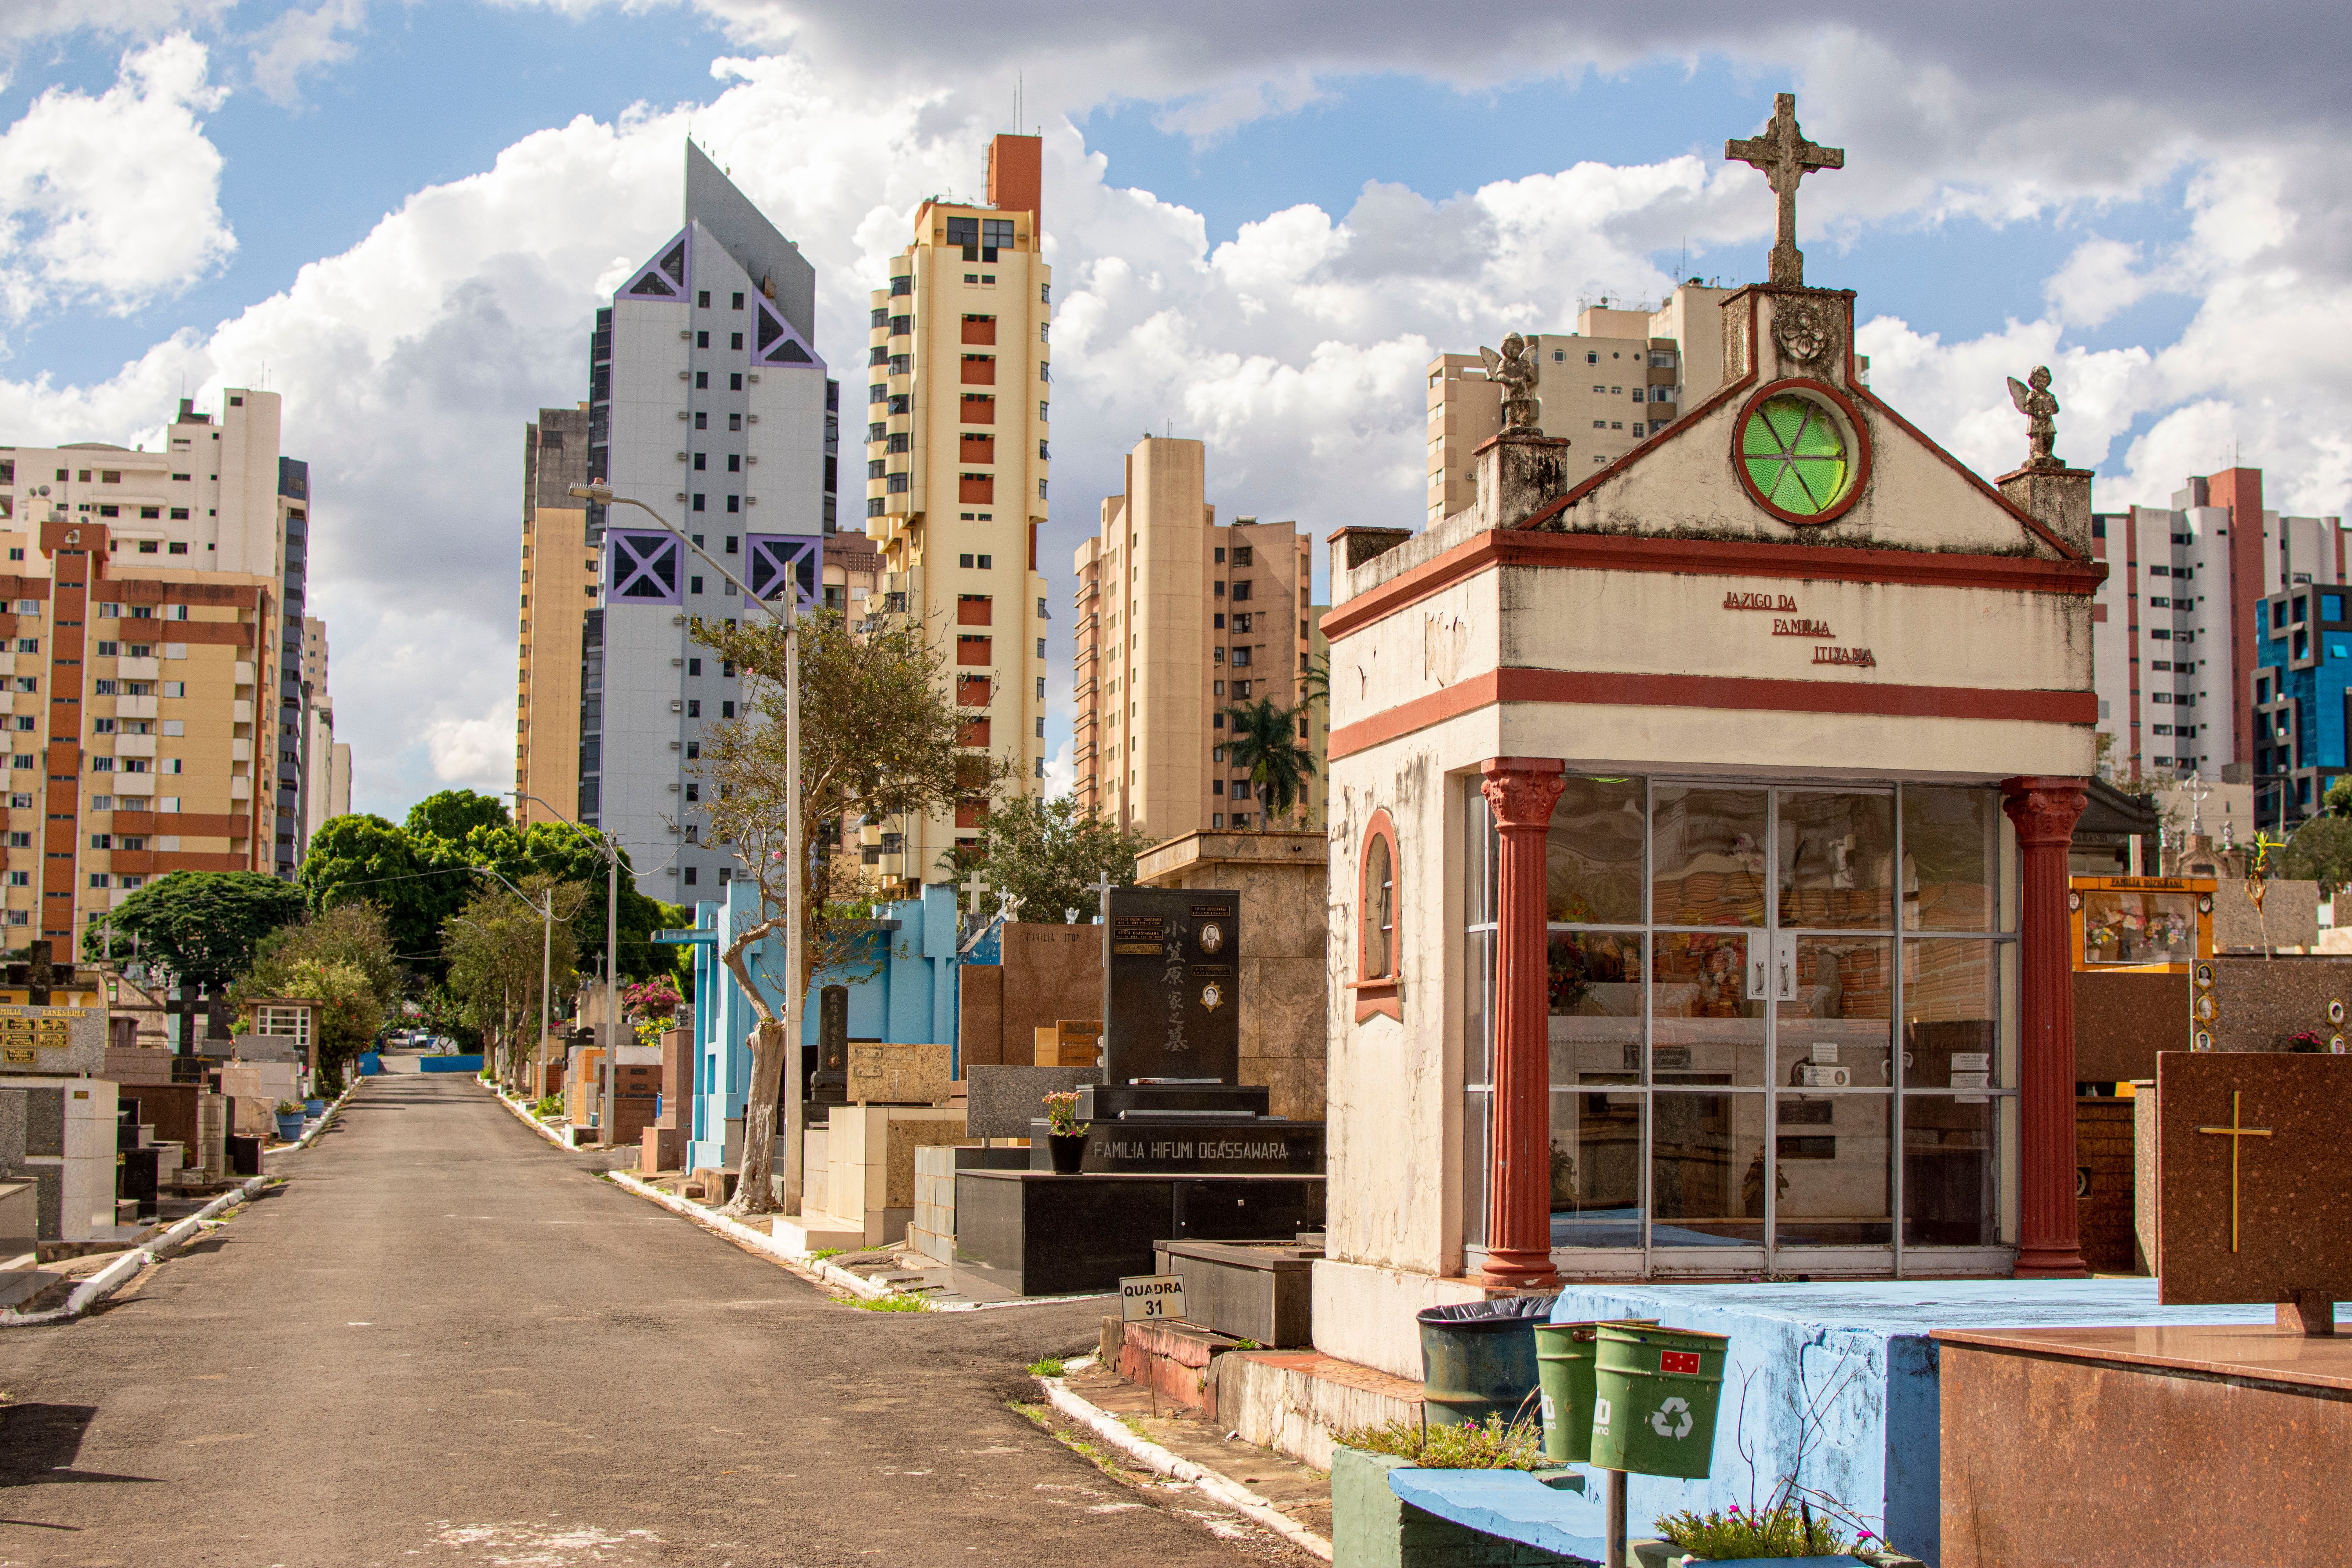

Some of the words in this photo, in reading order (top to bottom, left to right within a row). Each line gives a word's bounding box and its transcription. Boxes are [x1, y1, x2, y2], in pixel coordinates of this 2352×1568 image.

[1723, 592, 1772, 609] JAZIGO
[1778, 594, 1797, 611] DA
[1773, 619, 1831, 637] FAMILIA
[1813, 646, 1876, 666] ITIYAMA
[1161, 920, 1189, 1052] 小笠原家之墓
[1094, 1141, 1144, 1158] FAMILIA
[1151, 1142, 1192, 1159] HIFUMI
[1198, 1142, 1287, 1159] OGASSAWARA
[1124, 1282, 1183, 1297] QUADRA
[1145, 1299, 1162, 1316] 31
